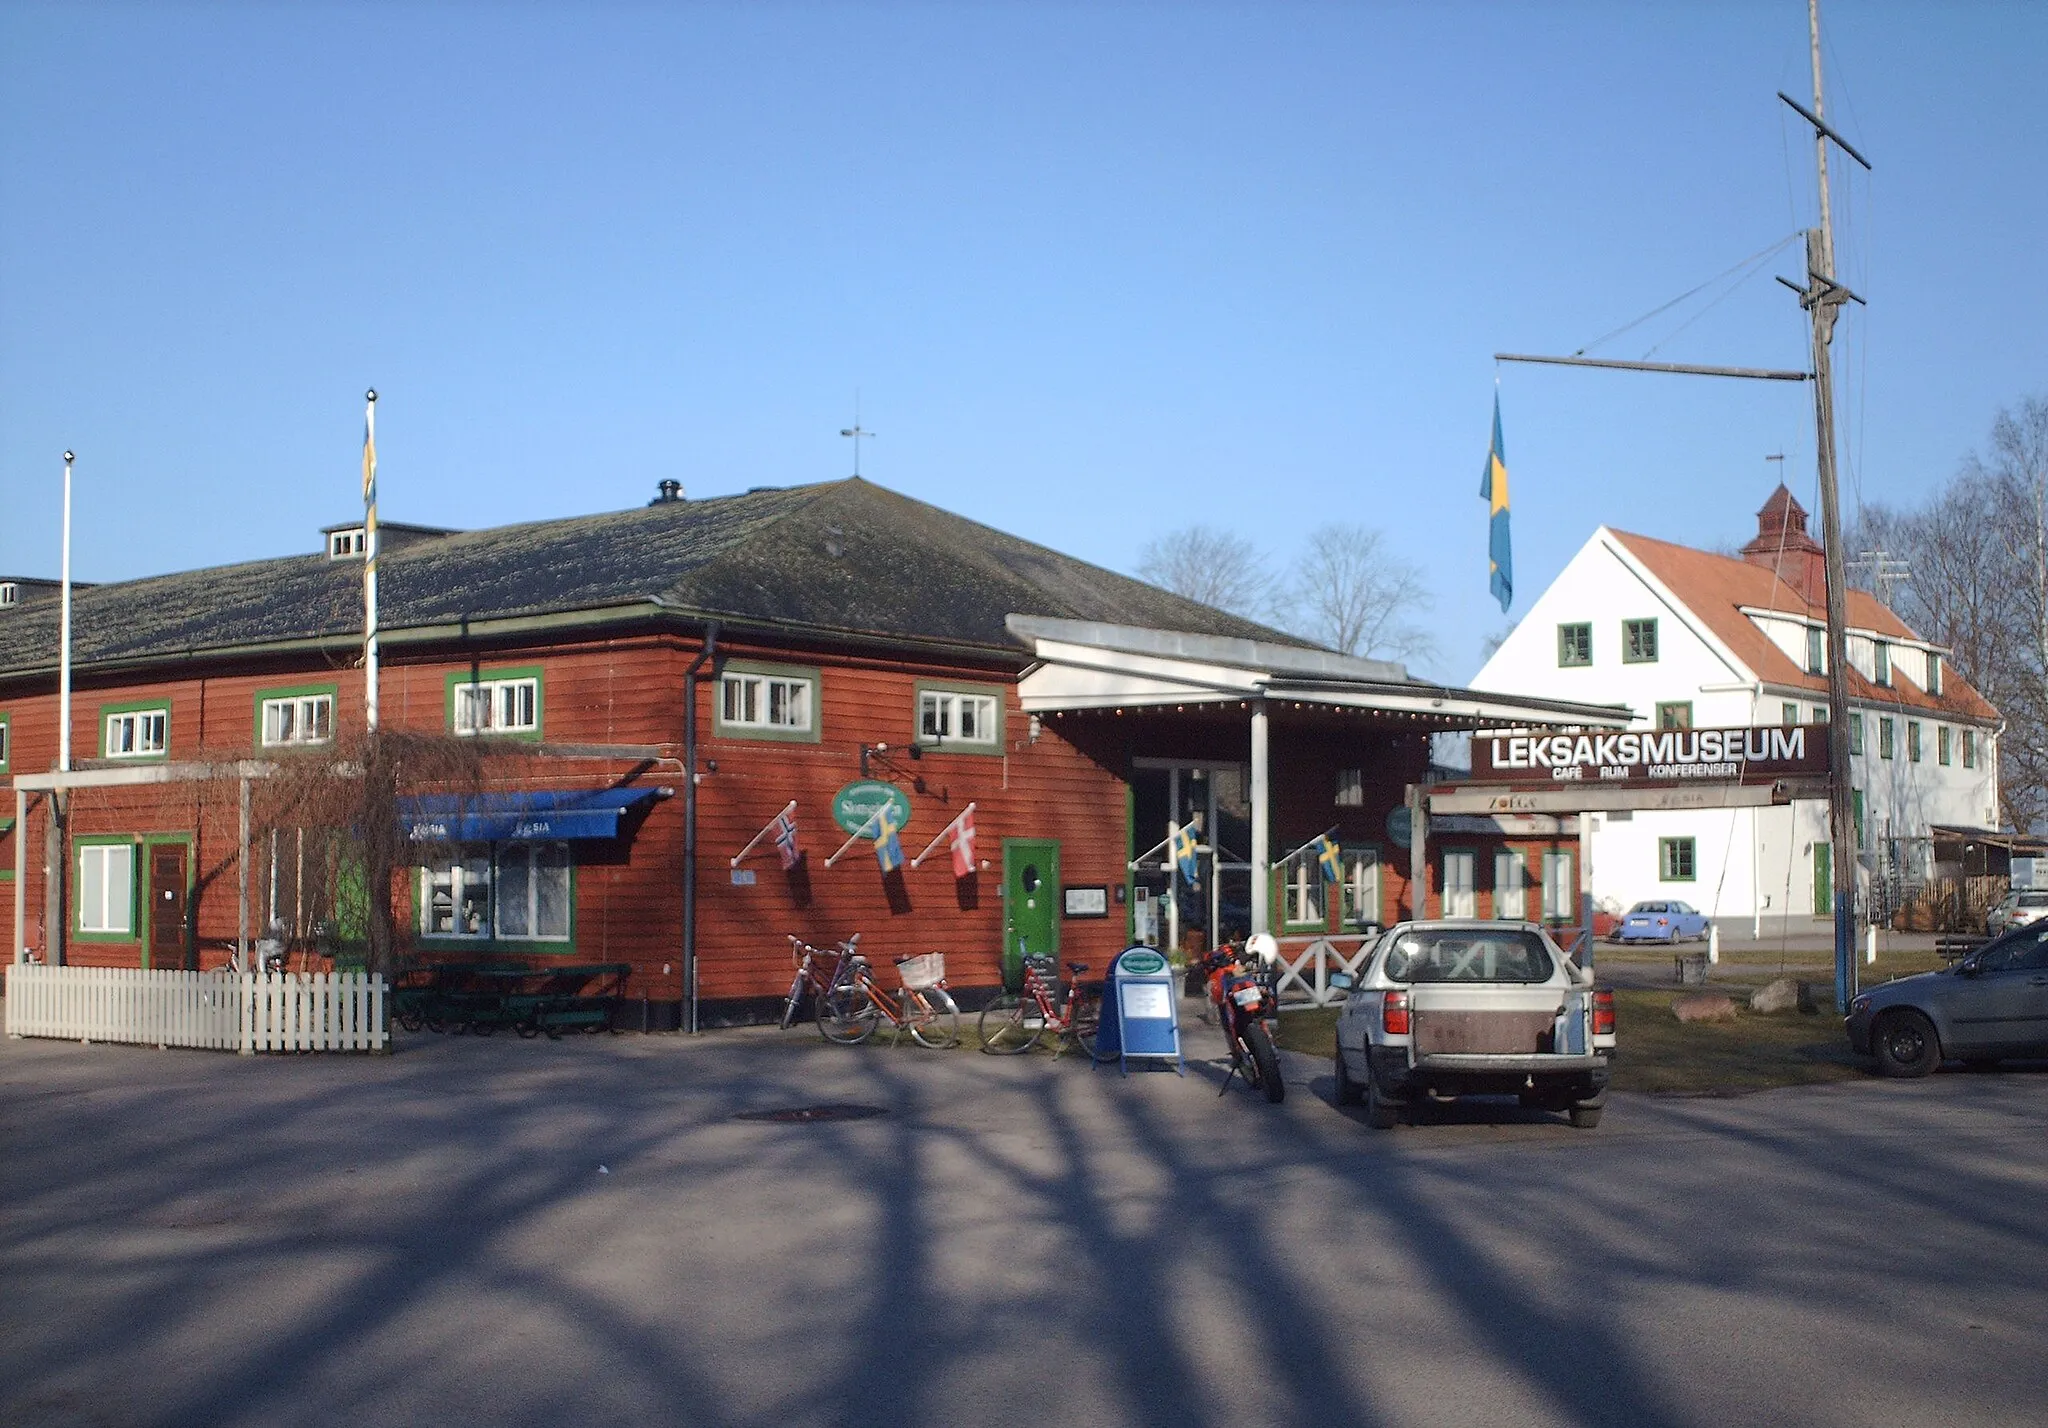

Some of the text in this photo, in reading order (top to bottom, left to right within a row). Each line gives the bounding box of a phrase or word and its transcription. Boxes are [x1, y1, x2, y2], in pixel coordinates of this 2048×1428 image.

[1491, 727, 1805, 769] LEKSAKSMUSEUM
[1600, 766, 1629, 779] RUM
[1647, 762, 1737, 779] KONFERENSER
